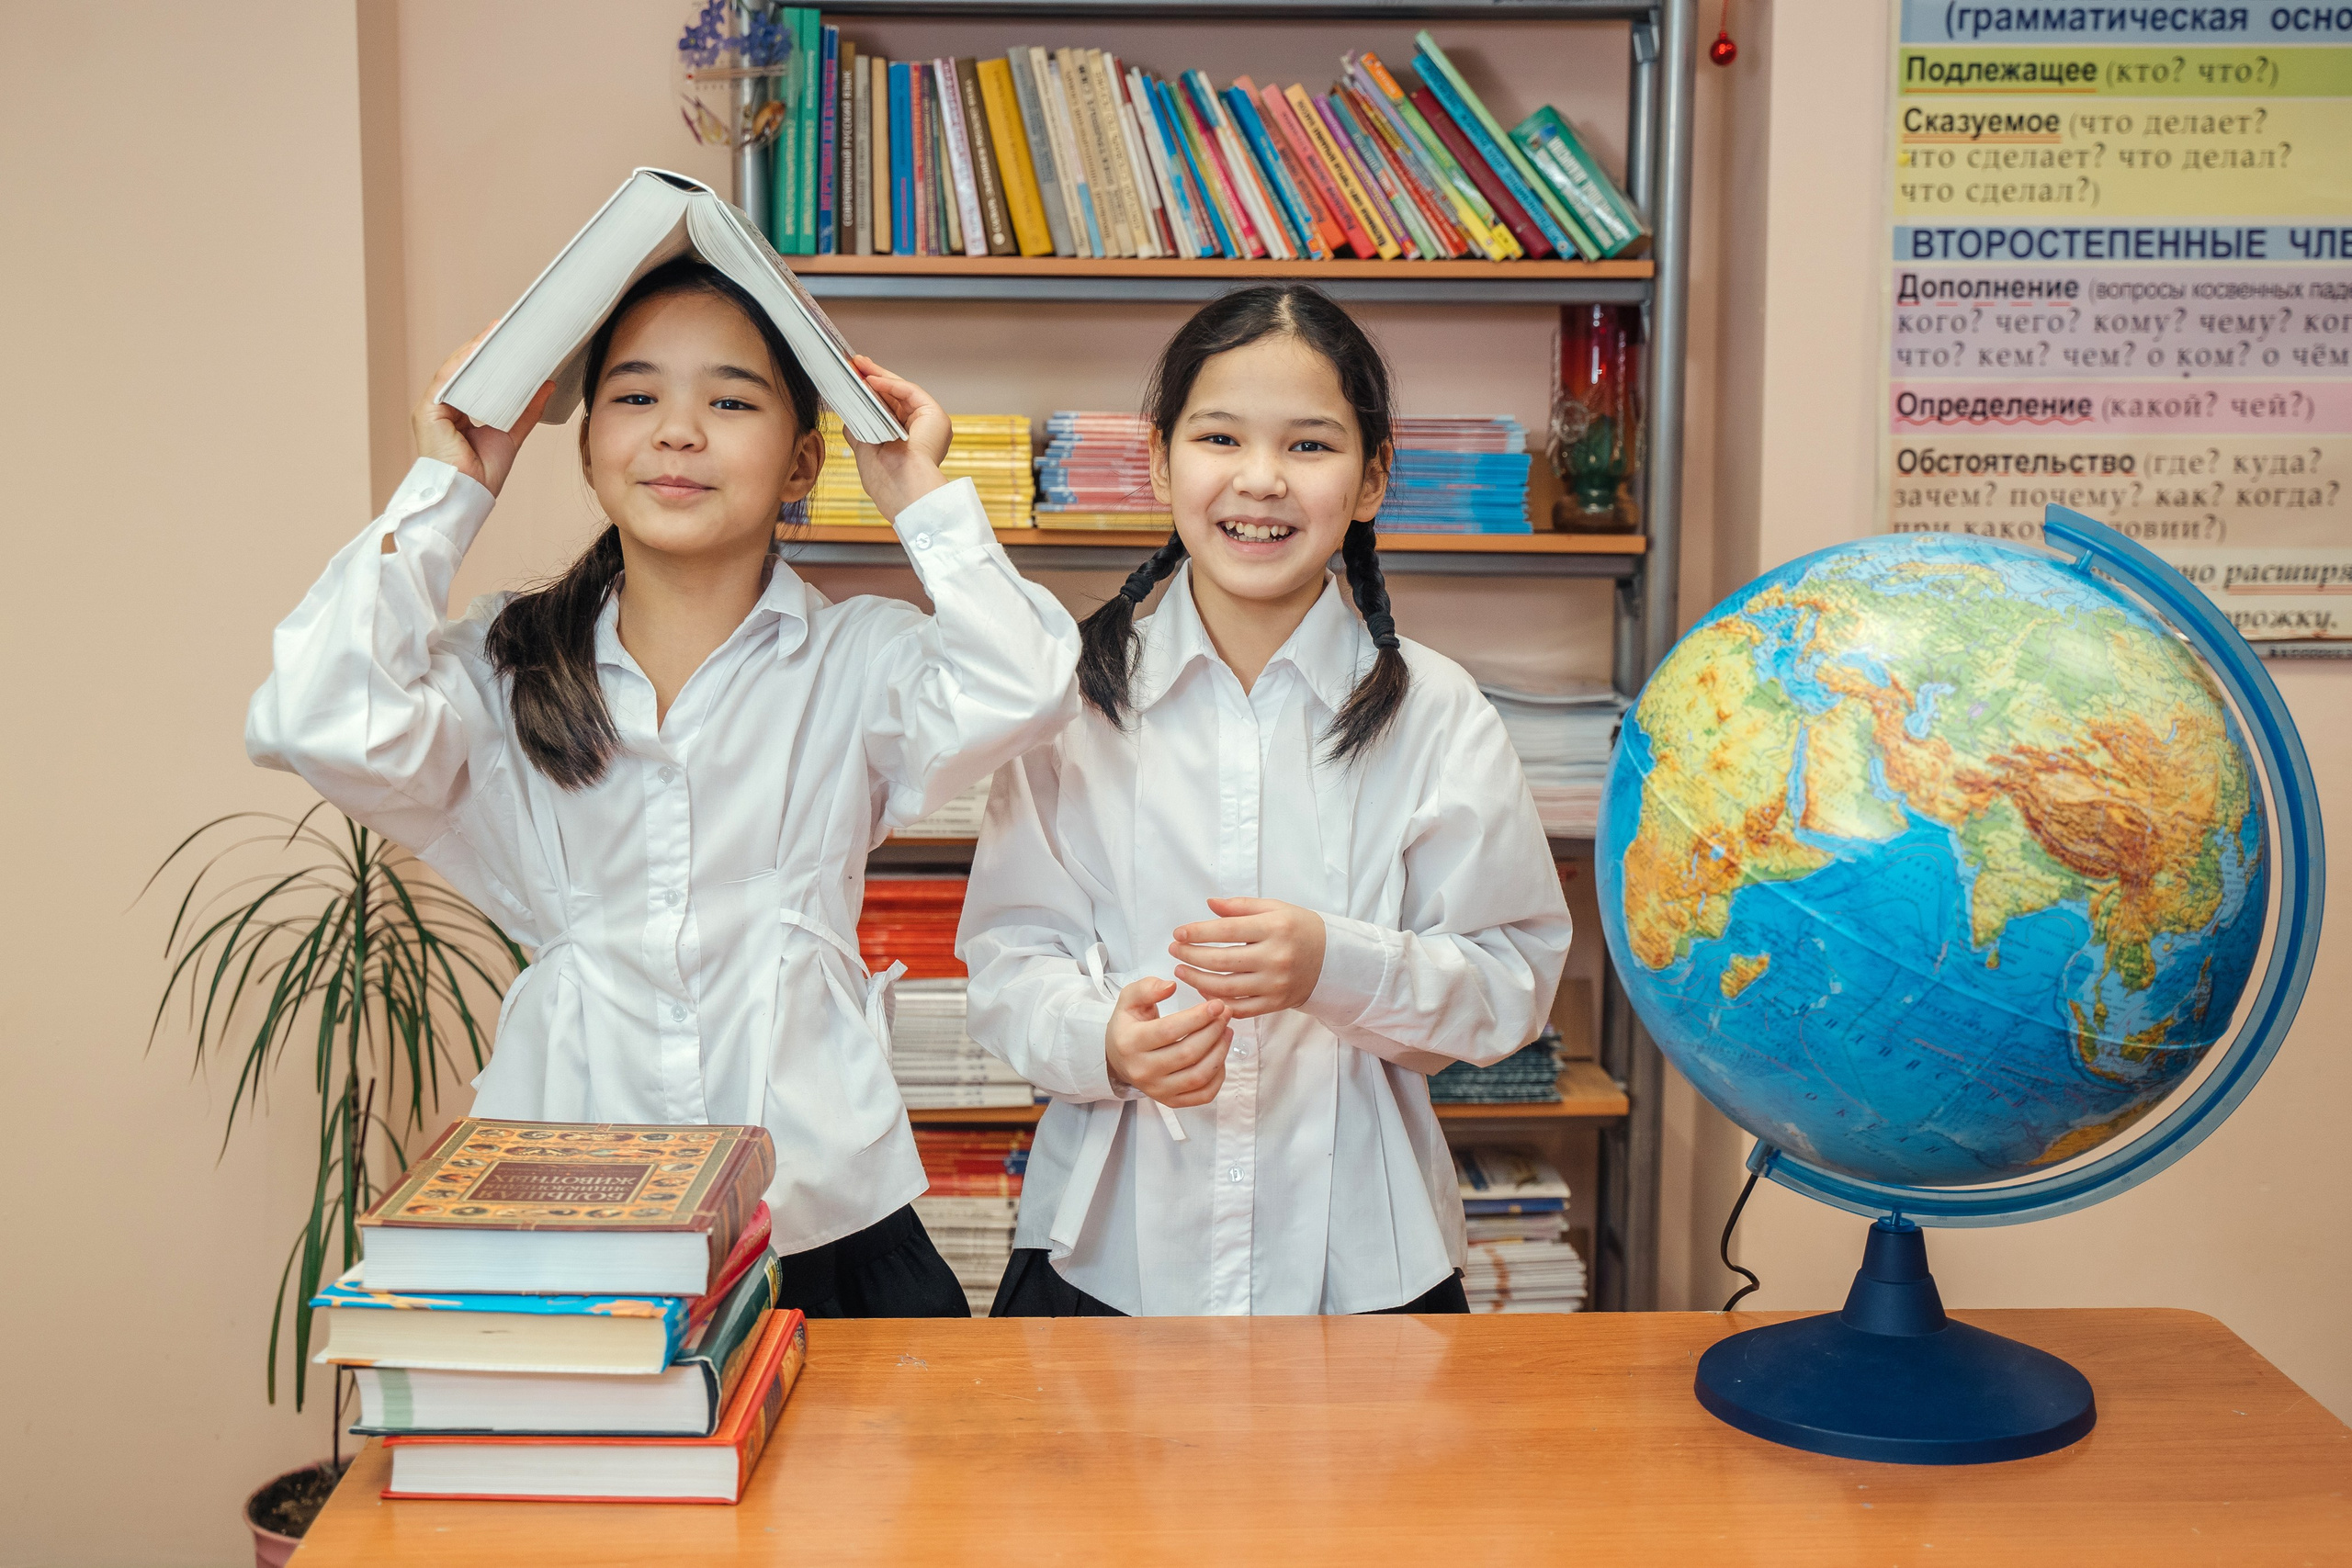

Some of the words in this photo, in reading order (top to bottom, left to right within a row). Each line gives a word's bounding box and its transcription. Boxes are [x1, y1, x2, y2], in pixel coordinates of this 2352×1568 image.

[1945, 1, 2248, 39] (грамматическая
[2270, 6, 2352, 31] осно
[842, 70, 853, 98] ЯЗЫК
[1906, 56, 2098, 85] Подлежащее
[2106, 56, 2186, 89] (кто?
[2199, 56, 2279, 89] что?)
[842, 100, 853, 149] РУССКИЙ
[1904, 107, 2061, 141] Сказуемое
[2069, 112, 2133, 138] (что
[2143, 107, 2269, 137] делает?
[1966, 142, 2107, 172] сделает?
[2119, 148, 2173, 169] что
[2182, 142, 2291, 171] делал?
[842, 150, 853, 227] СОВРЕМЕННЫЙ
[1901, 183, 1955, 204] что
[1965, 176, 2101, 208] сделал?)
[1912, 229, 2267, 260] ВТОРОСТЕПЕННЫЕ
[1897, 275, 2079, 302] Дополнение
[2088, 276, 2186, 305] (вопросы
[2191, 282, 2303, 300] косвенных
[1897, 308, 1983, 333] кого?
[1996, 308, 2081, 333] чего?
[2093, 307, 2188, 343] кому?
[2199, 307, 2292, 343] чему?
[1897, 340, 1965, 367] что?
[1978, 340, 2050, 367] кем?
[2064, 340, 2136, 367] чем?
[2147, 348, 2165, 367] о
[2177, 340, 2251, 367] ком?
[2262, 347, 2280, 367] о
[1896, 392, 2093, 421] Определение
[2101, 391, 2218, 423] (какой?
[2231, 391, 2316, 423] чей?)
[1897, 448, 2136, 474] Обстоятельство
[2143, 447, 2221, 480] (где?
[2233, 447, 2323, 482] куда?
[1894, 481, 1997, 508] зачем?
[2009, 480, 2143, 518] почему?
[2154, 480, 2224, 507] как?
[2236, 480, 2341, 508] когда?
[476, 1190, 625, 1201] БОЛЬШАЯ
[492, 1175, 637, 1185] ЖИВОТНЫХ
